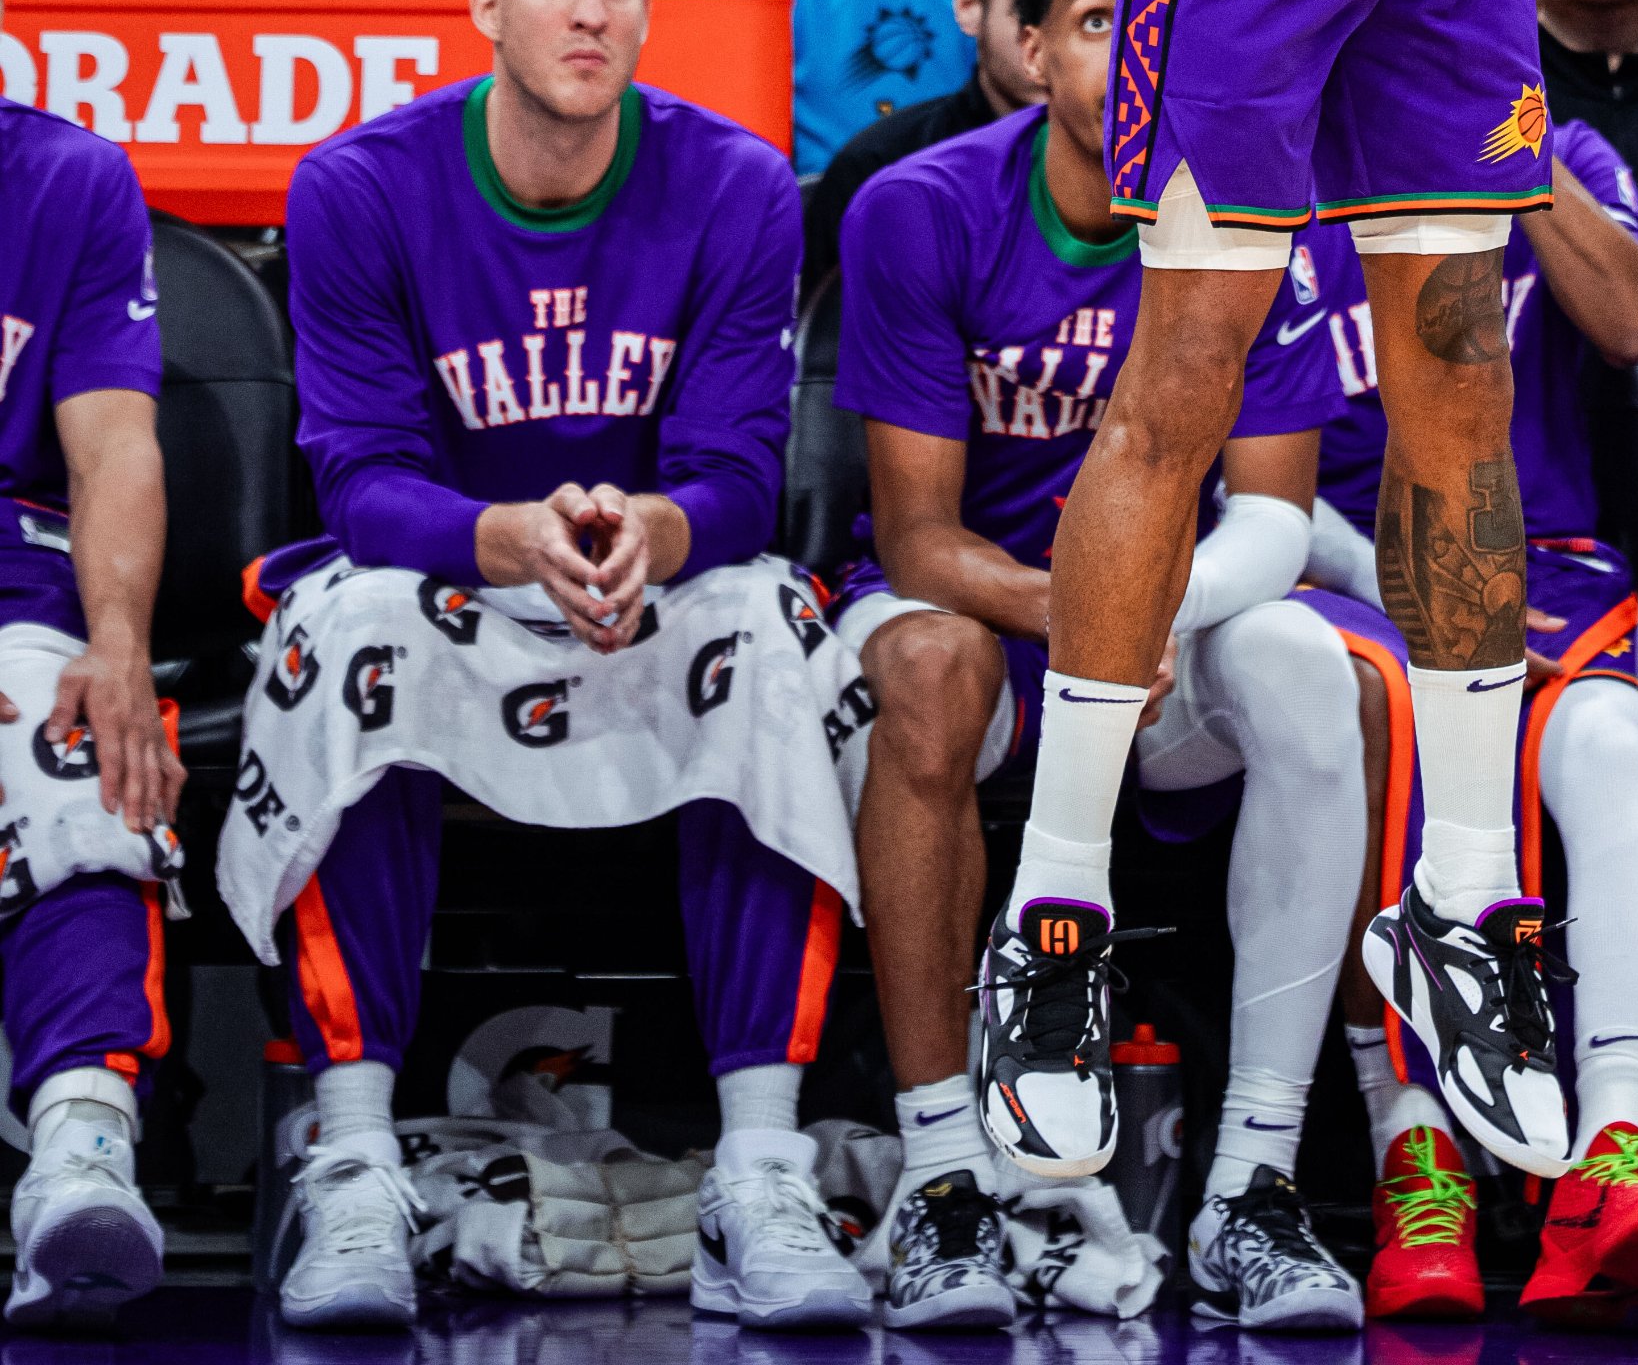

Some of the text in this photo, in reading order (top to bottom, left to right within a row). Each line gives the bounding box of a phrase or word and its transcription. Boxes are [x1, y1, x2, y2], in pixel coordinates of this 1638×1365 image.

[529, 286, 588, 329] THE
[433, 329, 677, 430] VALLEY
[342, 645, 396, 732] G
[502, 678, 571, 748] G
[687, 630, 740, 718] G
